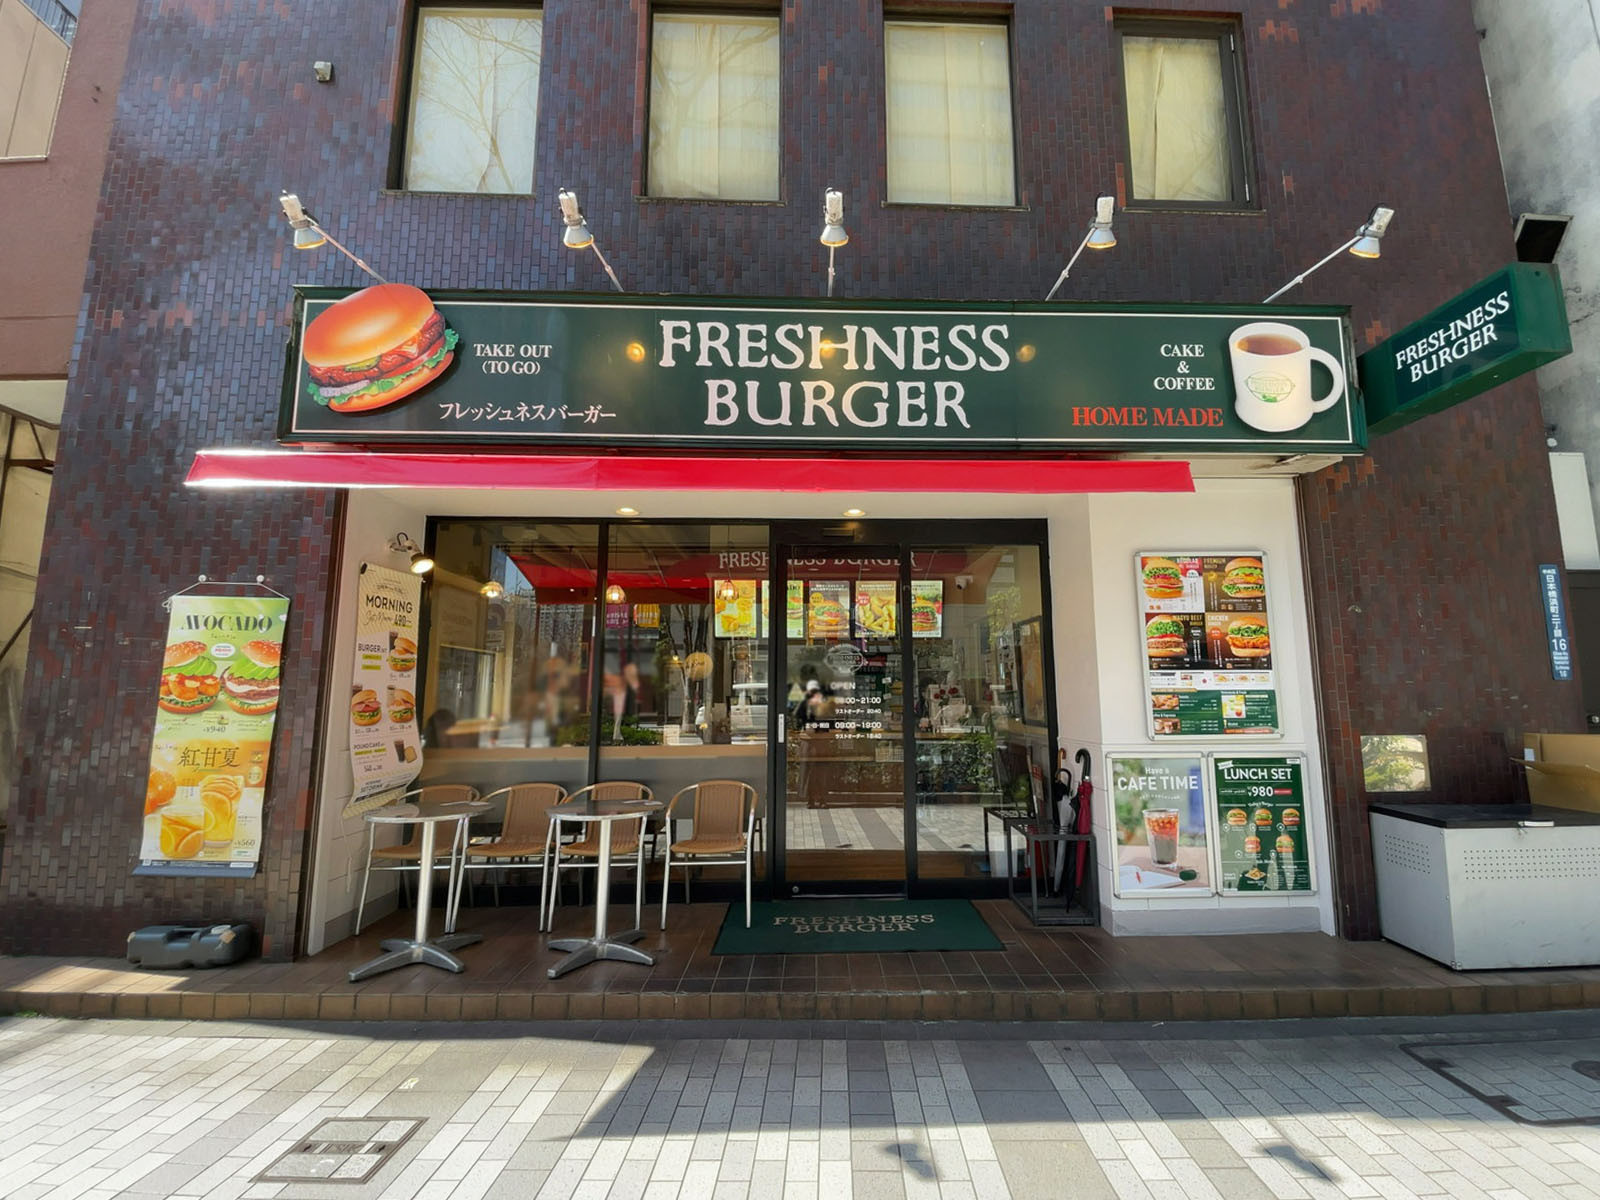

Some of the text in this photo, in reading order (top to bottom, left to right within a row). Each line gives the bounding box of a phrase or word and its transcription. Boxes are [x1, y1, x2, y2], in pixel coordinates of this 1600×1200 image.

[1395, 291, 1510, 370] FRESHNESS
[473, 343, 552, 359] TAKE OUT
[659, 319, 1010, 372] FRESHNESS
[1160, 343, 1205, 358] CAKE
[1410, 323, 1498, 383] BURGER
[1176, 360, 1190, 374] &
[1153, 377, 1216, 391] COFFEE
[704, 378, 971, 429] BURGER
[438, 402, 617, 424] フレッシュネスバーガー
[1072, 406, 1224, 427] HOME MADE
[366, 594, 413, 614] MORNING
[181, 614, 273, 632] AVOCADO
[1552, 638, 1567, 651] 16
[830, 681, 856, 690] OPEN
[177, 746, 241, 769] 紅甘夏
[1224, 768, 1292, 780] LUNCH SET
[1117, 775, 1199, 791] CAFE TIME
[773, 914, 935, 926] FRESHNESS
[793, 921, 917, 934] BURGER
